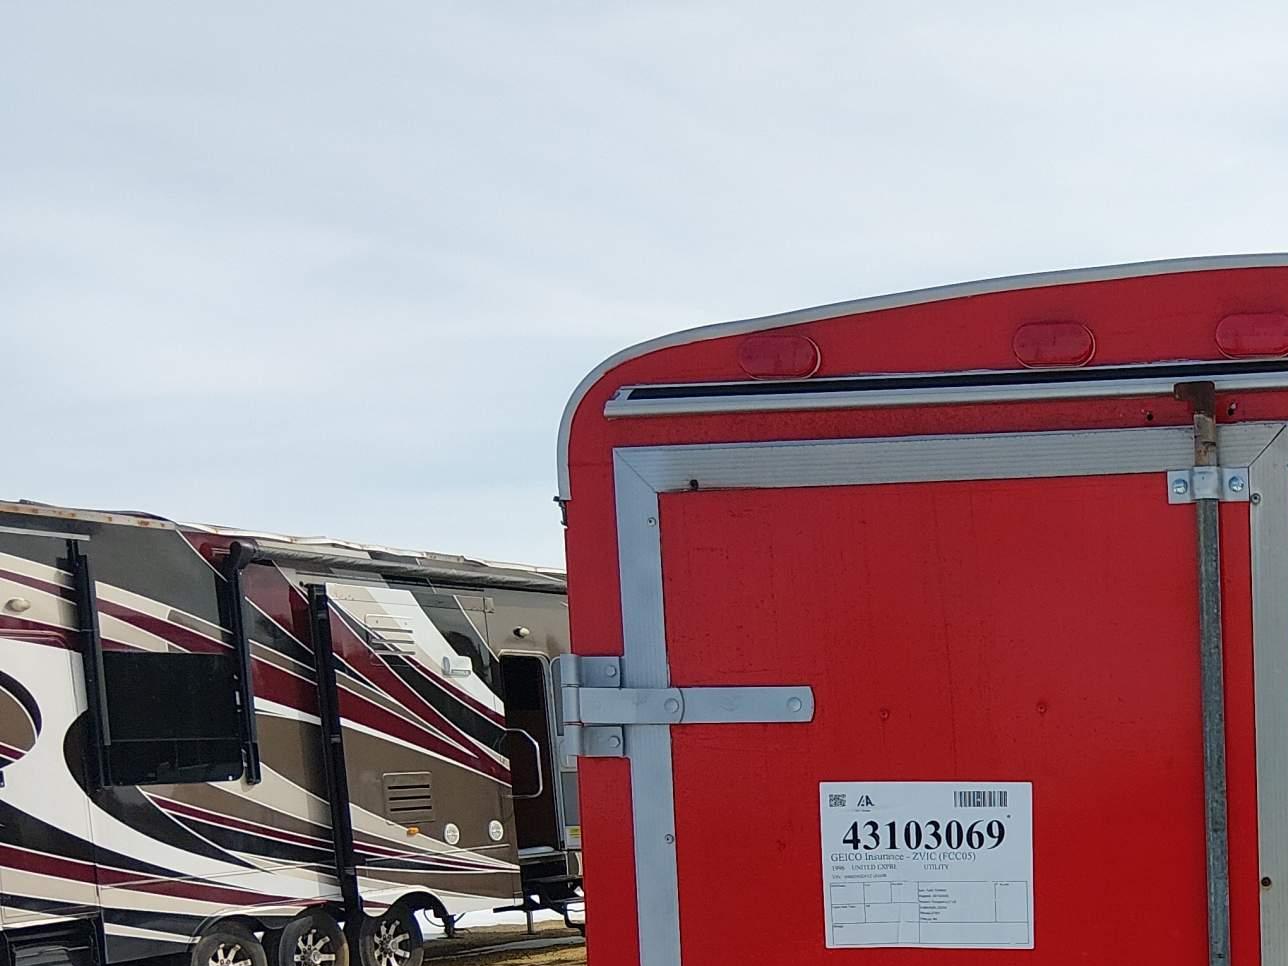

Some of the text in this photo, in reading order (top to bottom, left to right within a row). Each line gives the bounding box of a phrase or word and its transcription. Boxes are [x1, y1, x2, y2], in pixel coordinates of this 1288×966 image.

[842, 819, 1006, 850] 43103069
[830, 852, 863, 862] GEICO
[865, 852, 905, 861] Insurance
[912, 851, 937, 861] ZVIC
[938, 851, 976, 862] (FCC05)
